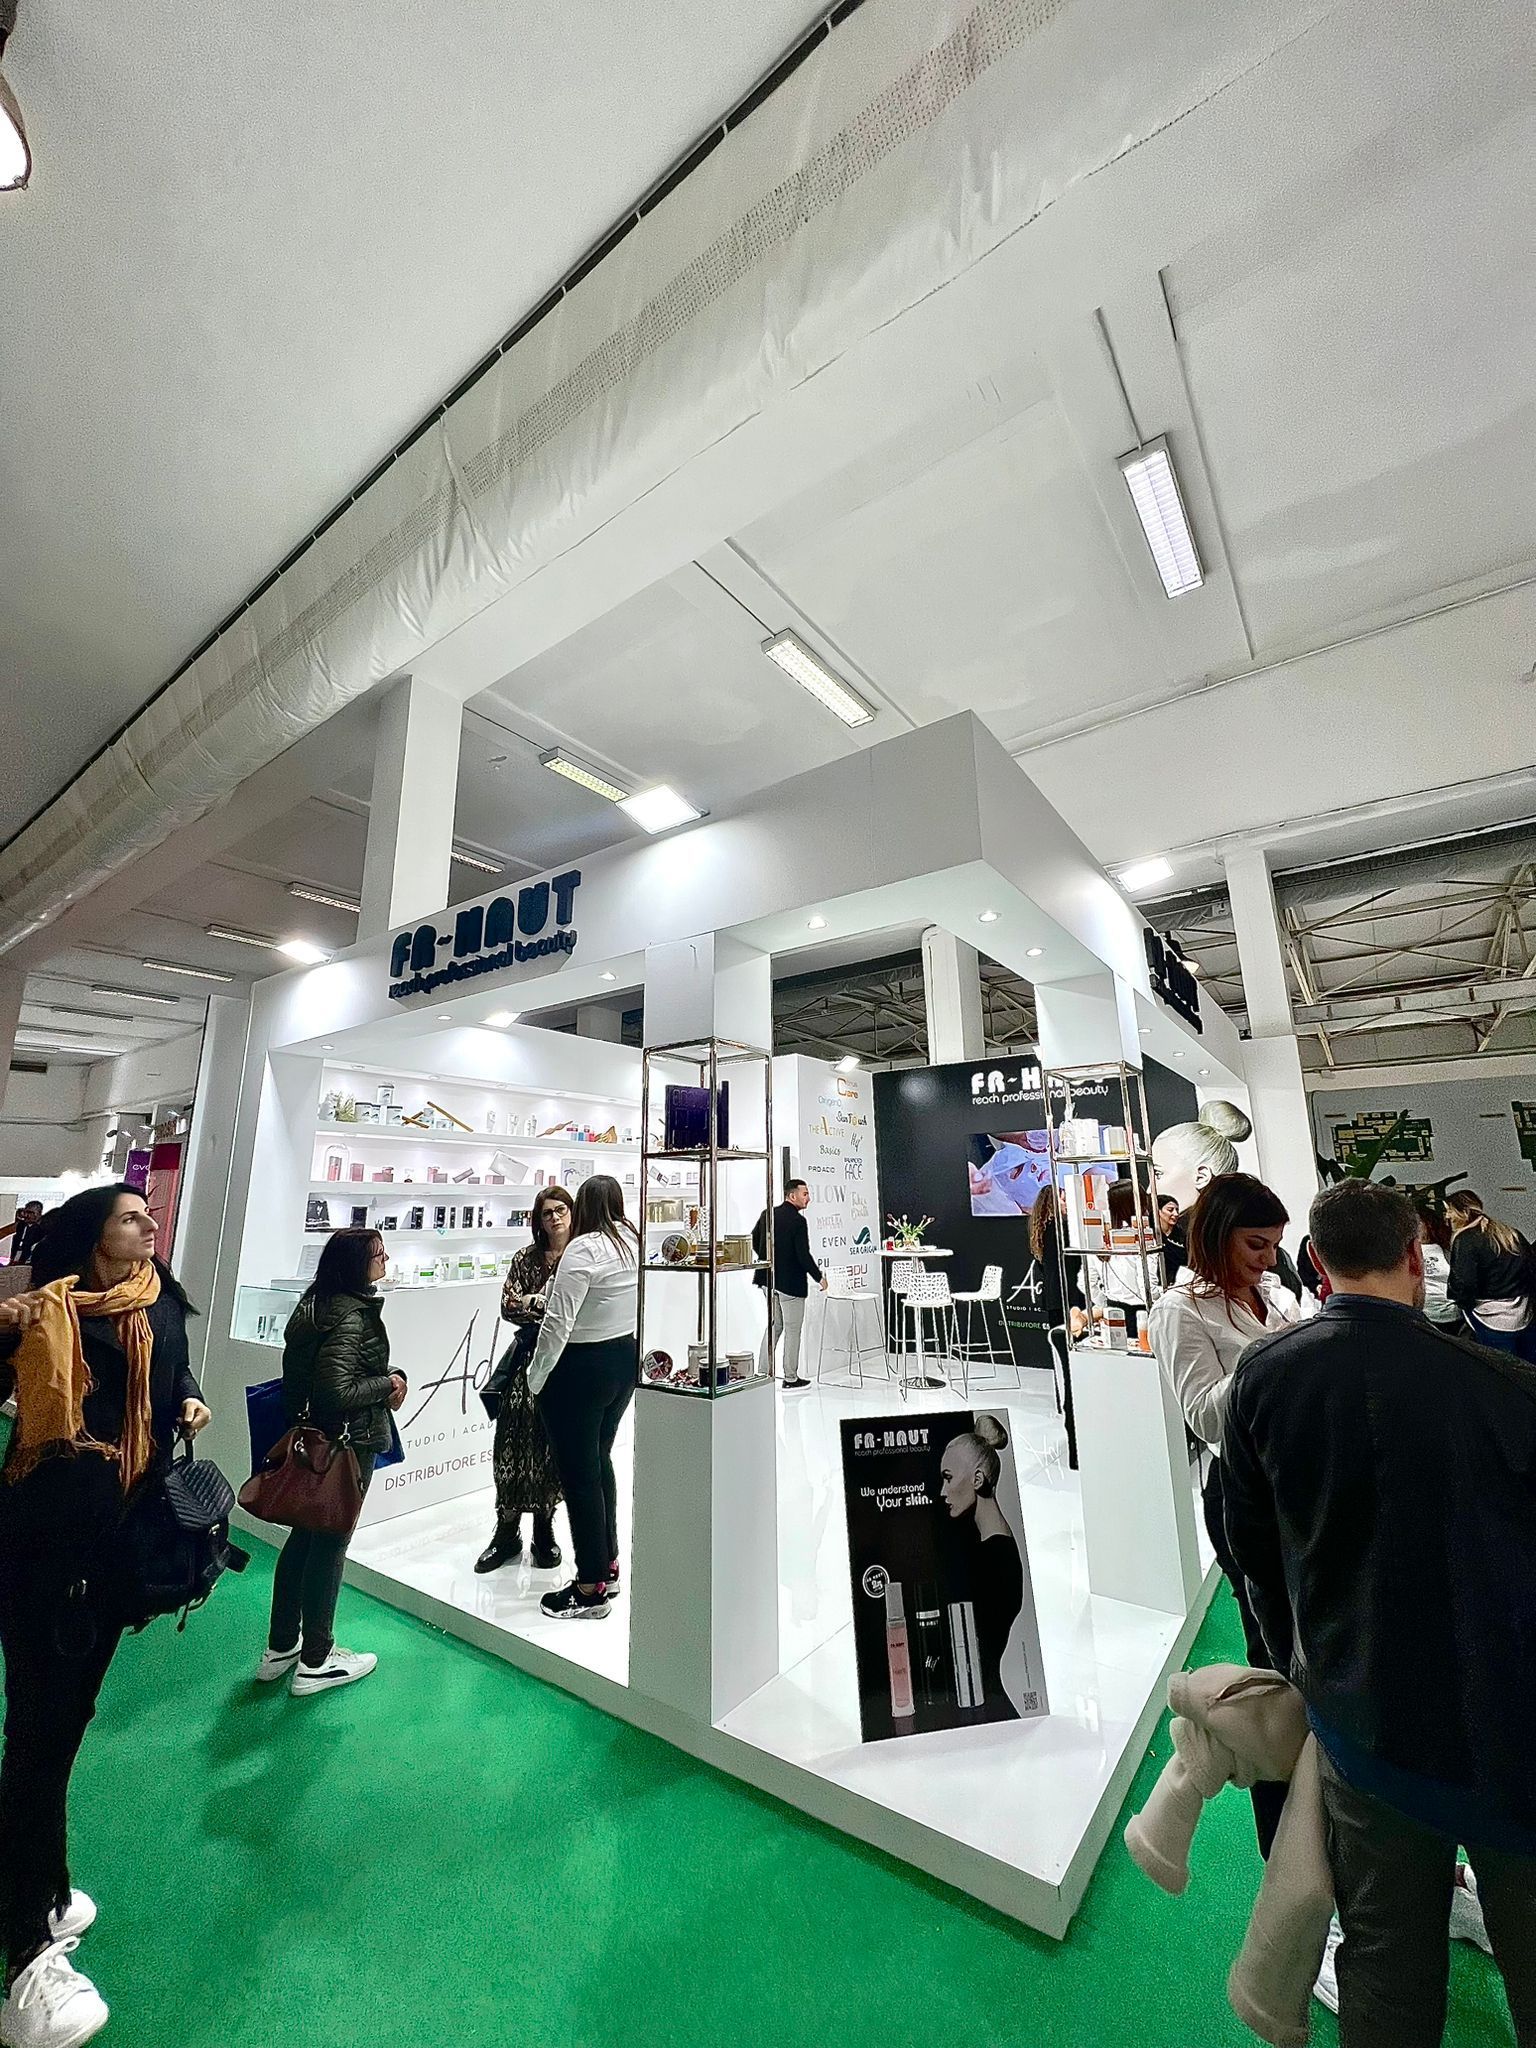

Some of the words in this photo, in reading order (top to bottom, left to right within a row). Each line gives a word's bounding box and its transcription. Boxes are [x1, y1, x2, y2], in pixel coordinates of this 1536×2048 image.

[972, 1093, 1000, 1105] reach
[1002, 1084, 1066, 1106] professinal
[822, 1236, 847, 1248] EVEN
[384, 1453, 478, 1491] DISTRIBUTORE
[860, 1486, 876, 1497] We
[877, 1482, 925, 1496] understand
[876, 1495, 903, 1513] Your
[905, 1492, 933, 1507] skin.
